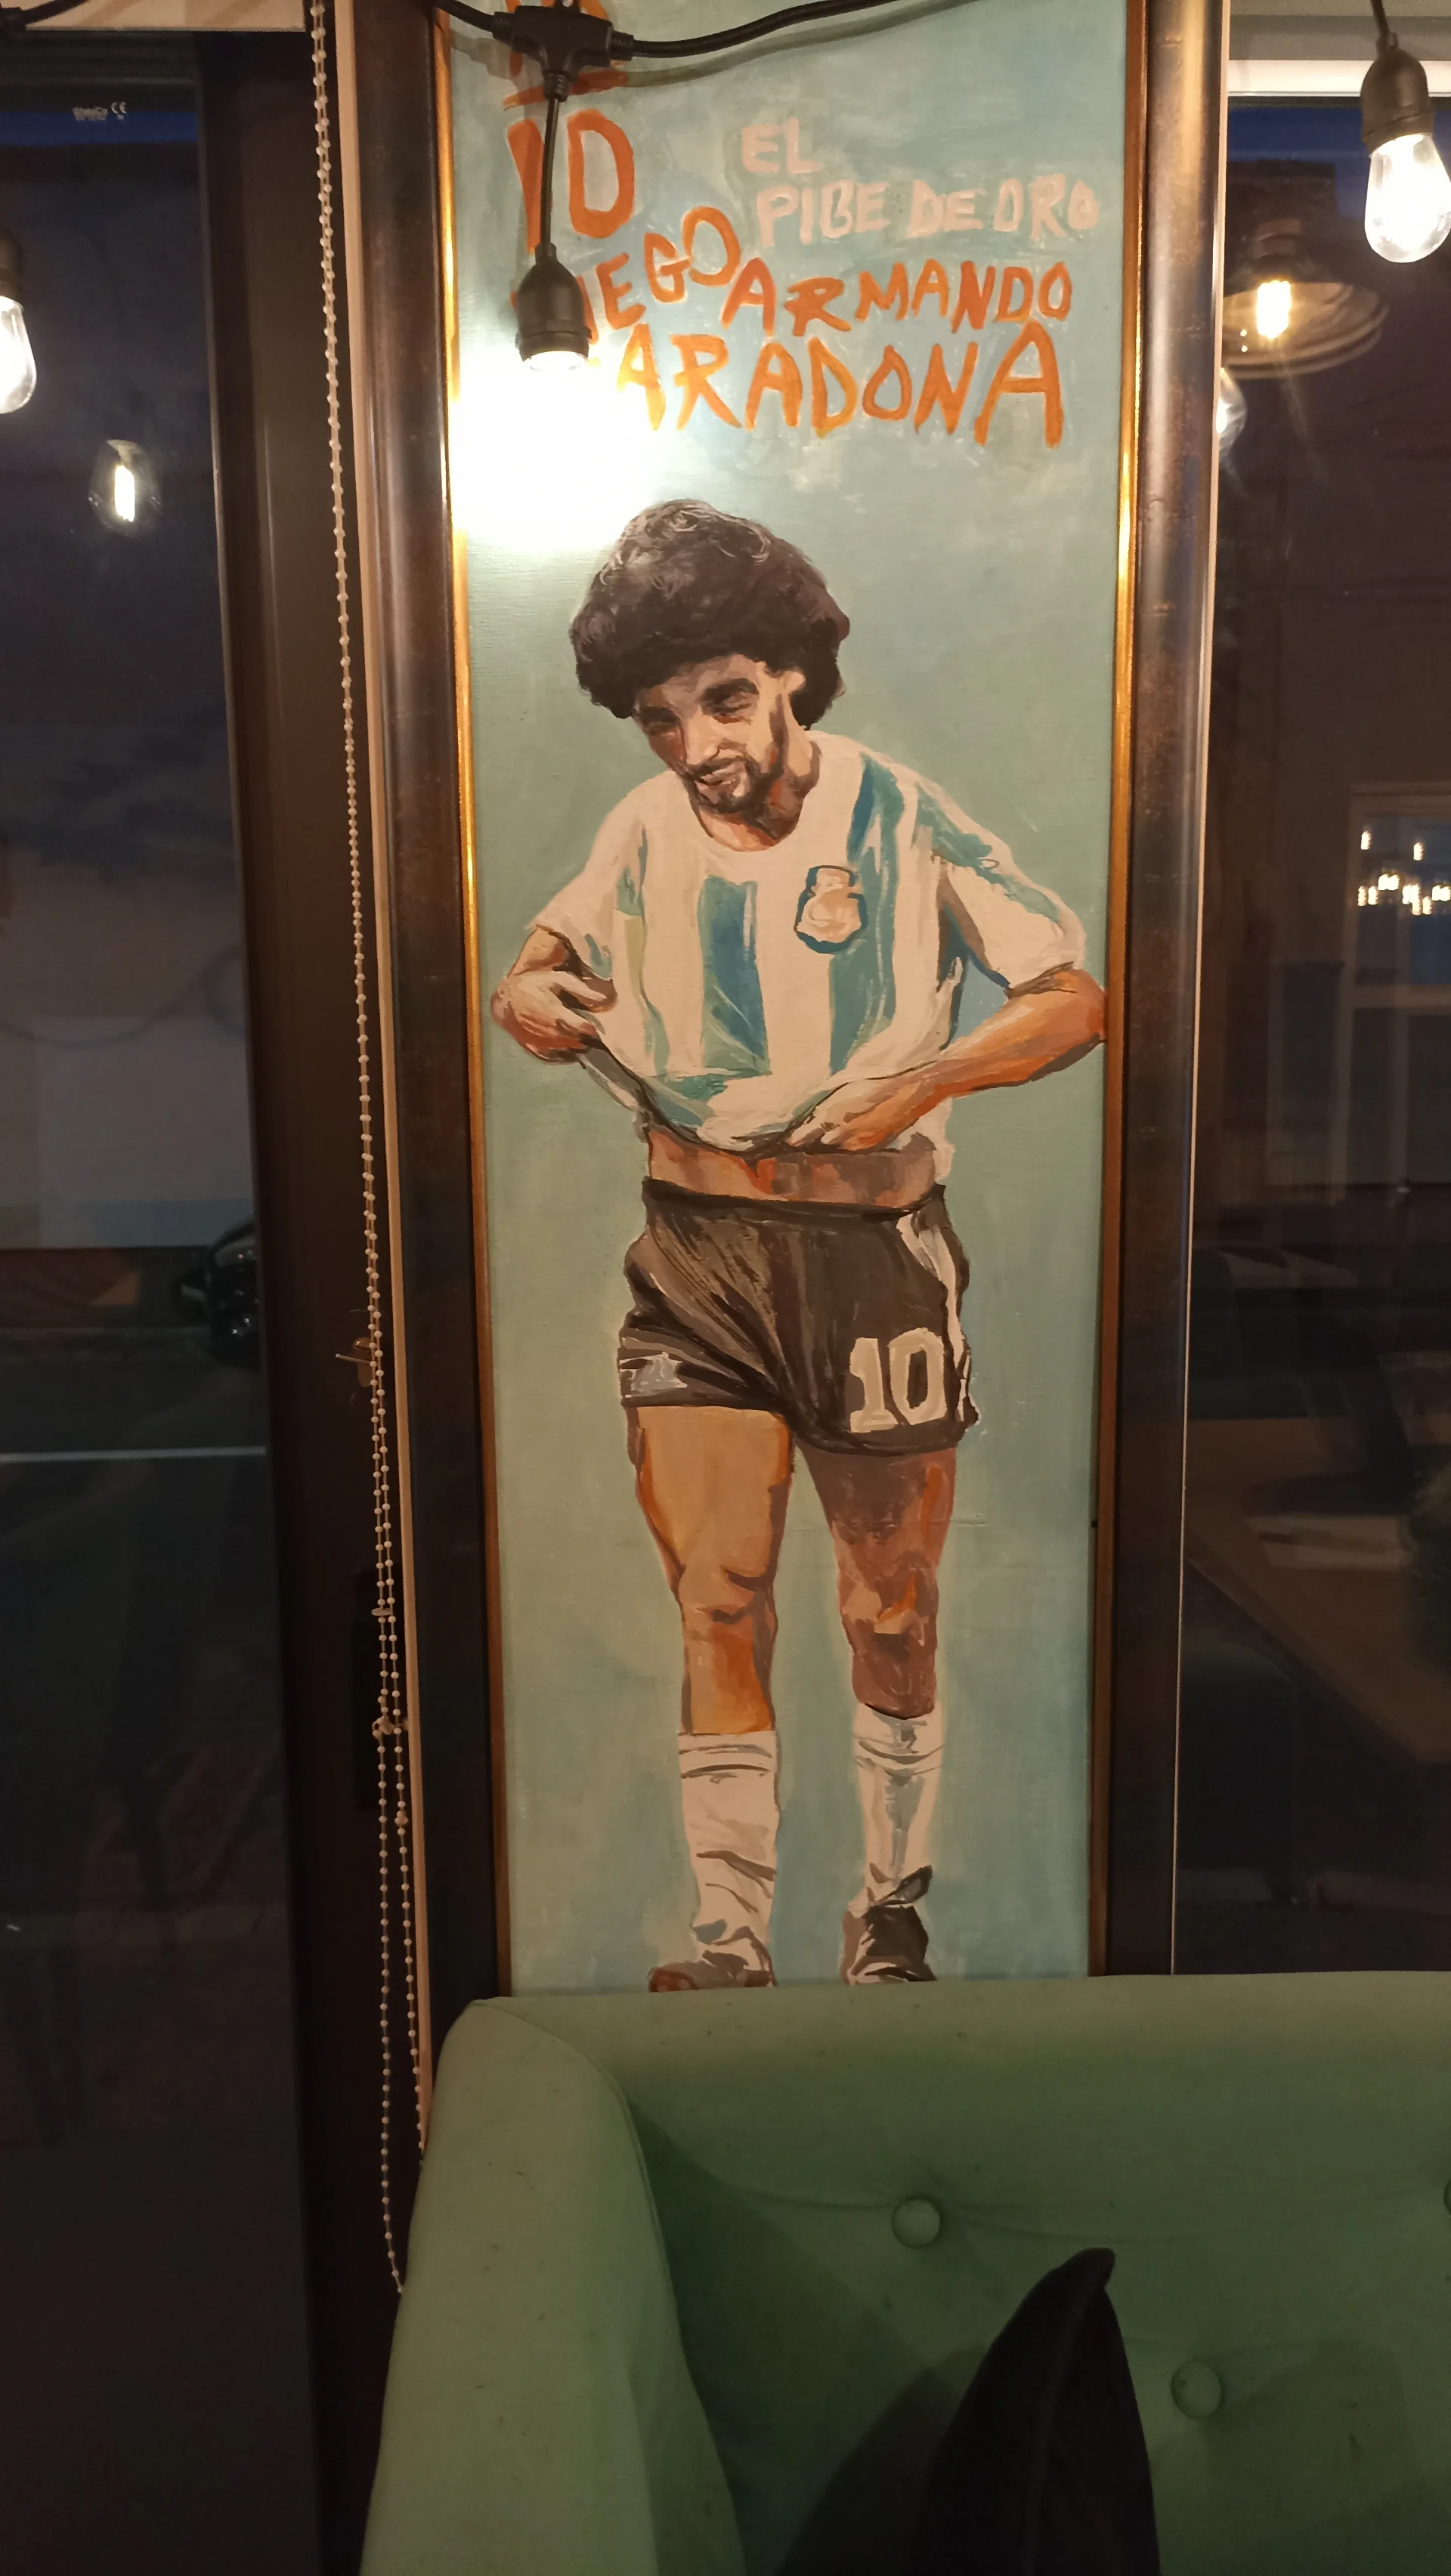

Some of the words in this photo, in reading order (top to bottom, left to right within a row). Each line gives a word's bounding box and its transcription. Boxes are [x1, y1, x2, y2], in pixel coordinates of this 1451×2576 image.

[741, 116, 823, 174] EL
[756, 178, 890, 247] PIBE
[907, 178, 984, 239] DE
[993, 173, 1100, 242] ORO
[509, 206, 742, 345] IEGO
[719, 256, 1073, 338] ARMANDO
[583, 320, 1065, 450] ARADONA
[849, 1326, 948, 1433] 10
